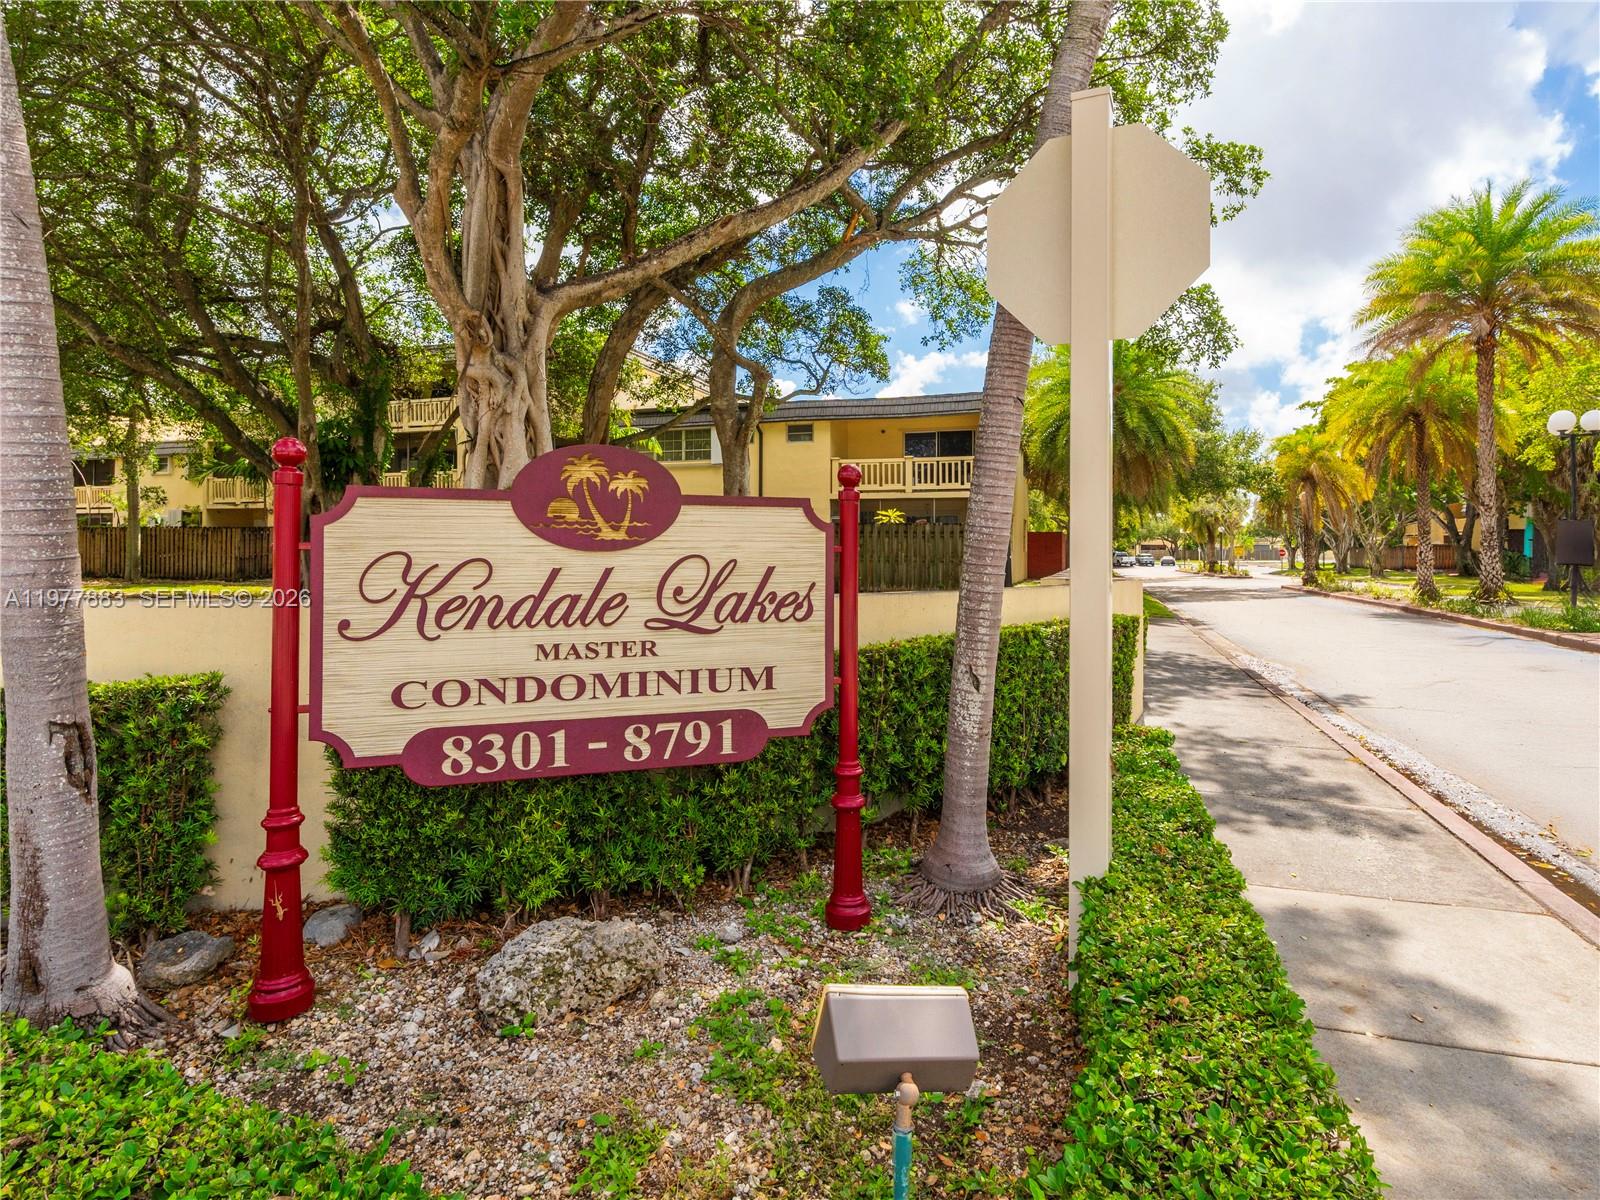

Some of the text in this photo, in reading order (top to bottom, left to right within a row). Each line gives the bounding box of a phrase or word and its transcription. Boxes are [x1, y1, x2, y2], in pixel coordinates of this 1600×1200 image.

[338, 551, 816, 641] Kendale Lakes
[535, 640, 659, 662] MASTER
[390, 665, 777, 710] CONDOMINIUM
[441, 729, 571, 777] 8301
[623, 718, 738, 763] 8791
